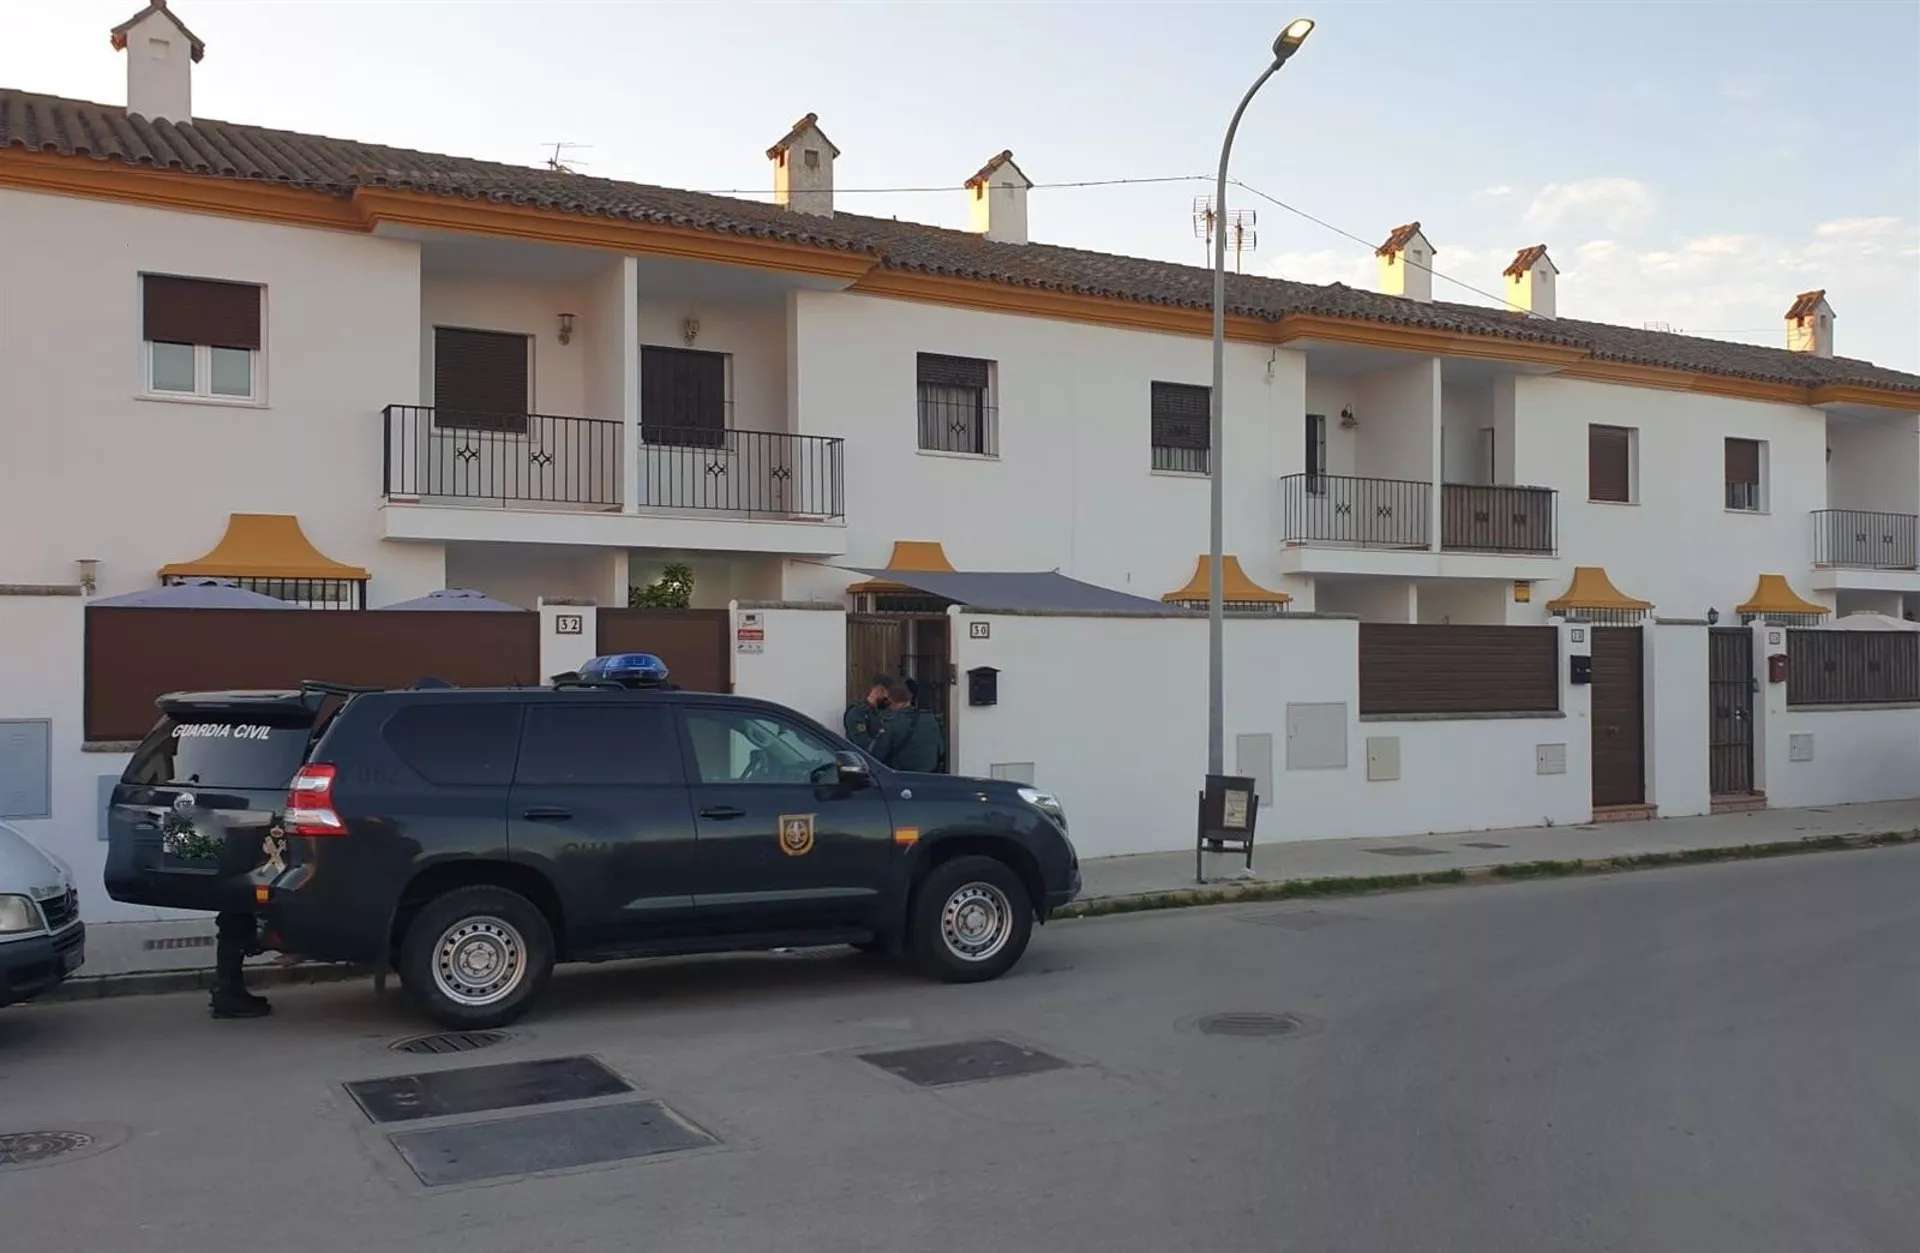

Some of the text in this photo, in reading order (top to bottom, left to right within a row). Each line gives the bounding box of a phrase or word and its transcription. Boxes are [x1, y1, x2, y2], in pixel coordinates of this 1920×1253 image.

[561, 619, 578, 630] 32
[172, 723, 271, 740] GUARDIA CIVIL
